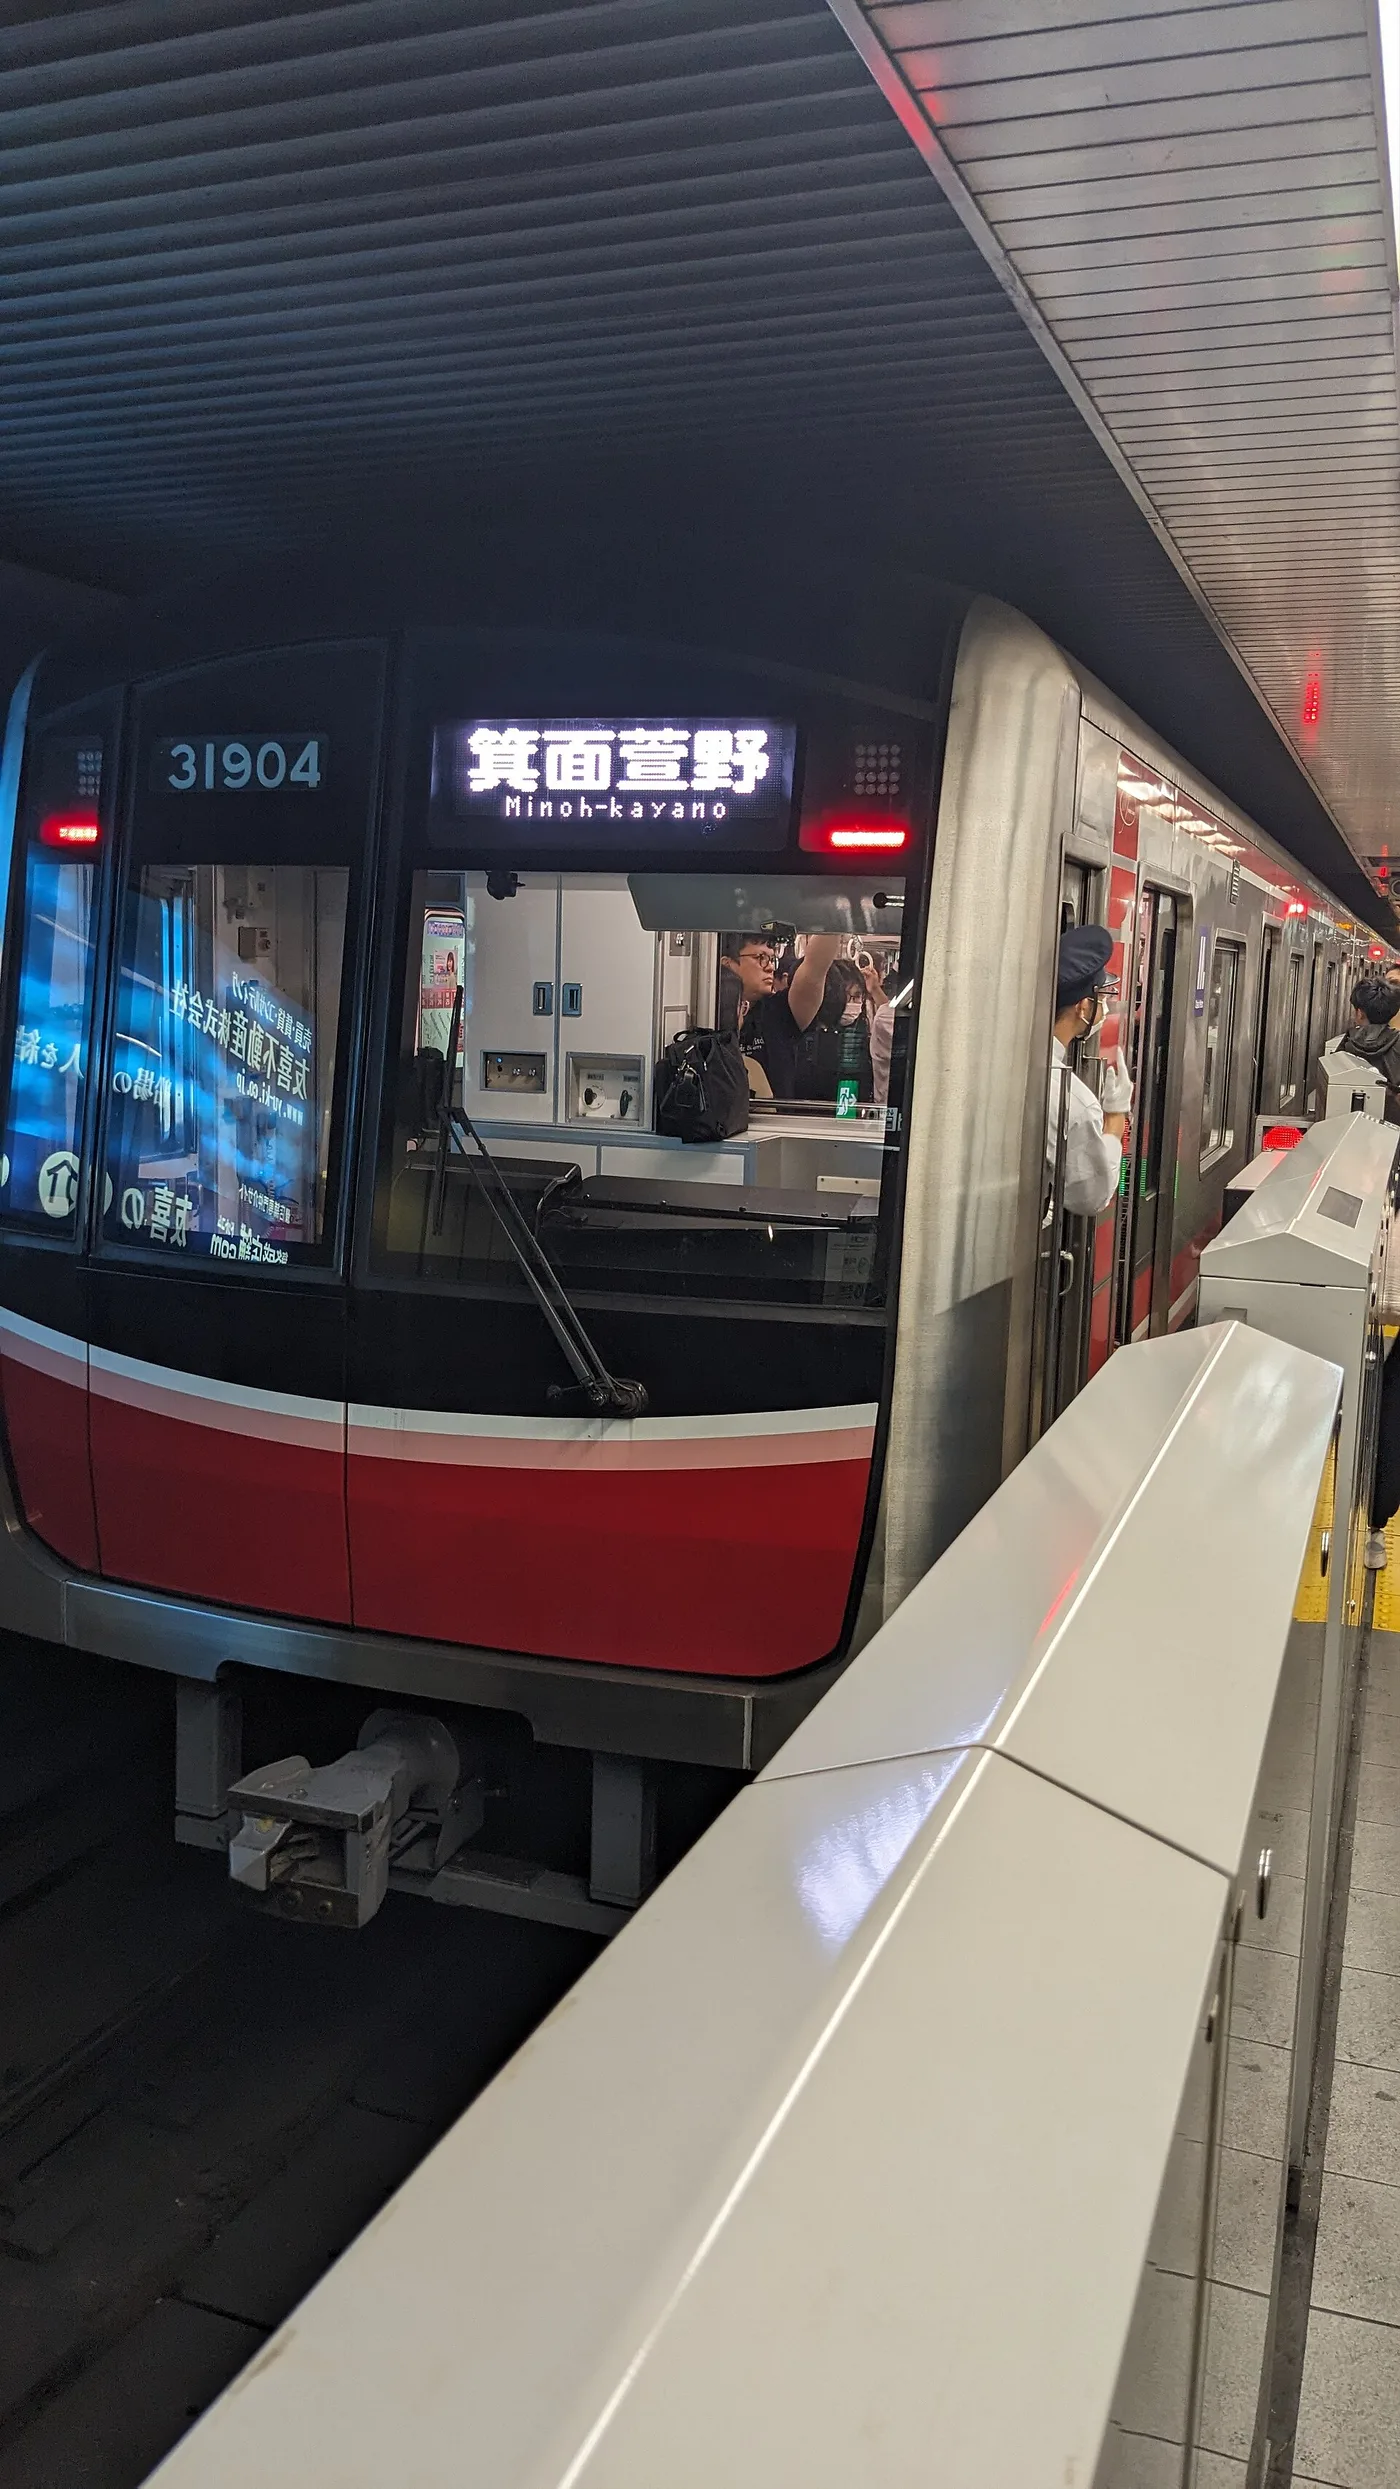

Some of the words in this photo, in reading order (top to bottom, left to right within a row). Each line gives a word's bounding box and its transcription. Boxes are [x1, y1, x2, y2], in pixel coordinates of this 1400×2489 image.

[168, 741, 321, 790] 31904
[467, 728, 770, 793] 箕面萱野
[505, 796, 728, 819] Minoh-kayano
